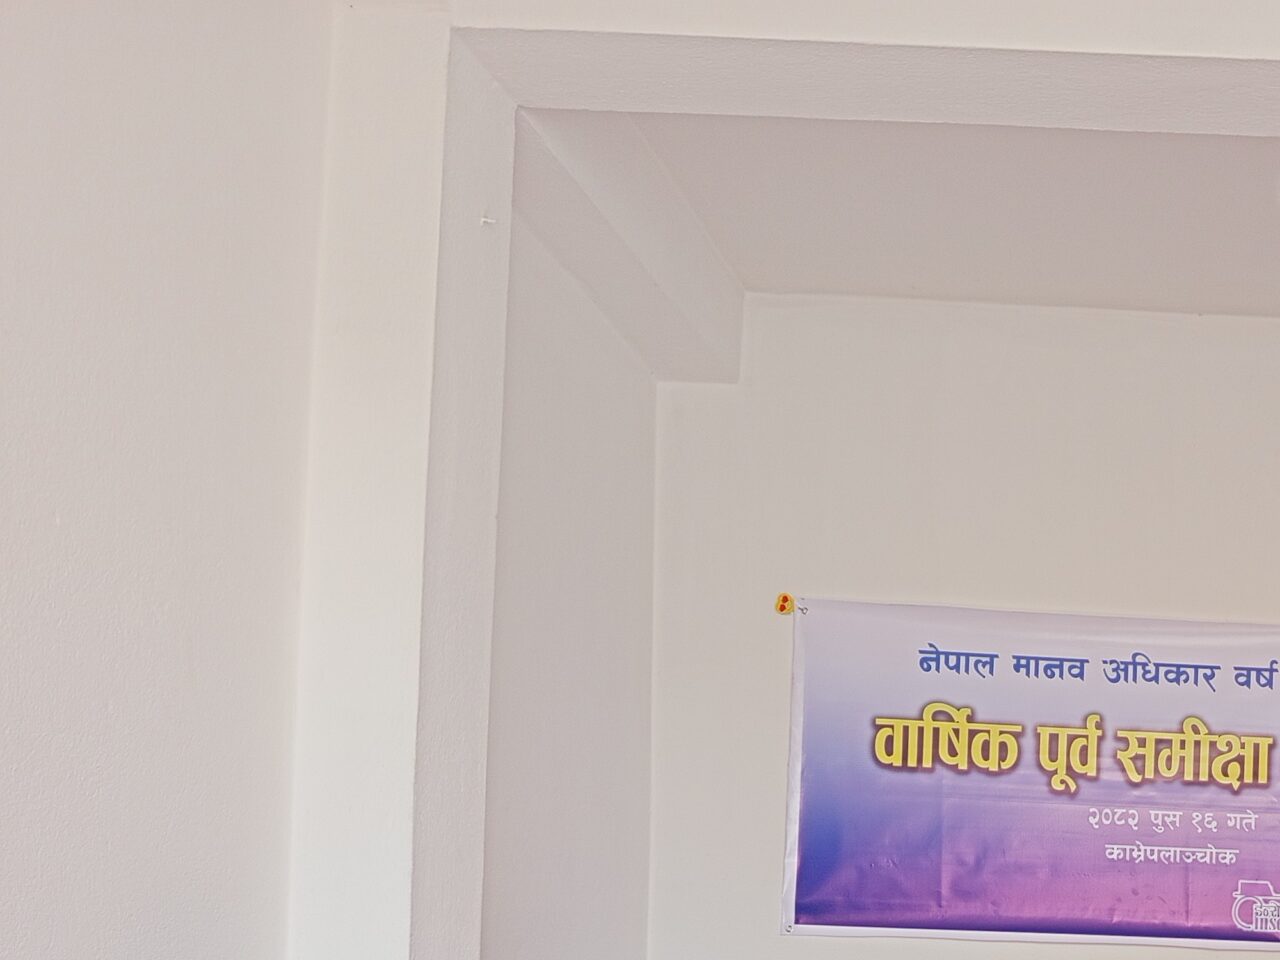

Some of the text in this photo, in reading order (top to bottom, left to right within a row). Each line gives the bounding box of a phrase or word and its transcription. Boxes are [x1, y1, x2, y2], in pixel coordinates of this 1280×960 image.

[918, 642, 999, 679] नेपाल
[1012, 654, 1089, 681] मानव
[1102, 652, 1221, 692] अधिकार
[1233, 659, 1279, 690] वर्ष
[874, 702, 1023, 772] वार्षिक
[1036, 714, 1103, 793] पूर्व
[1116, 716, 1274, 791] समीक्षा
[1088, 807, 1259, 833] २०८२ पुस १६ गते
[1104, 841, 1240, 865] काभ्रेपलाञ्चोक
